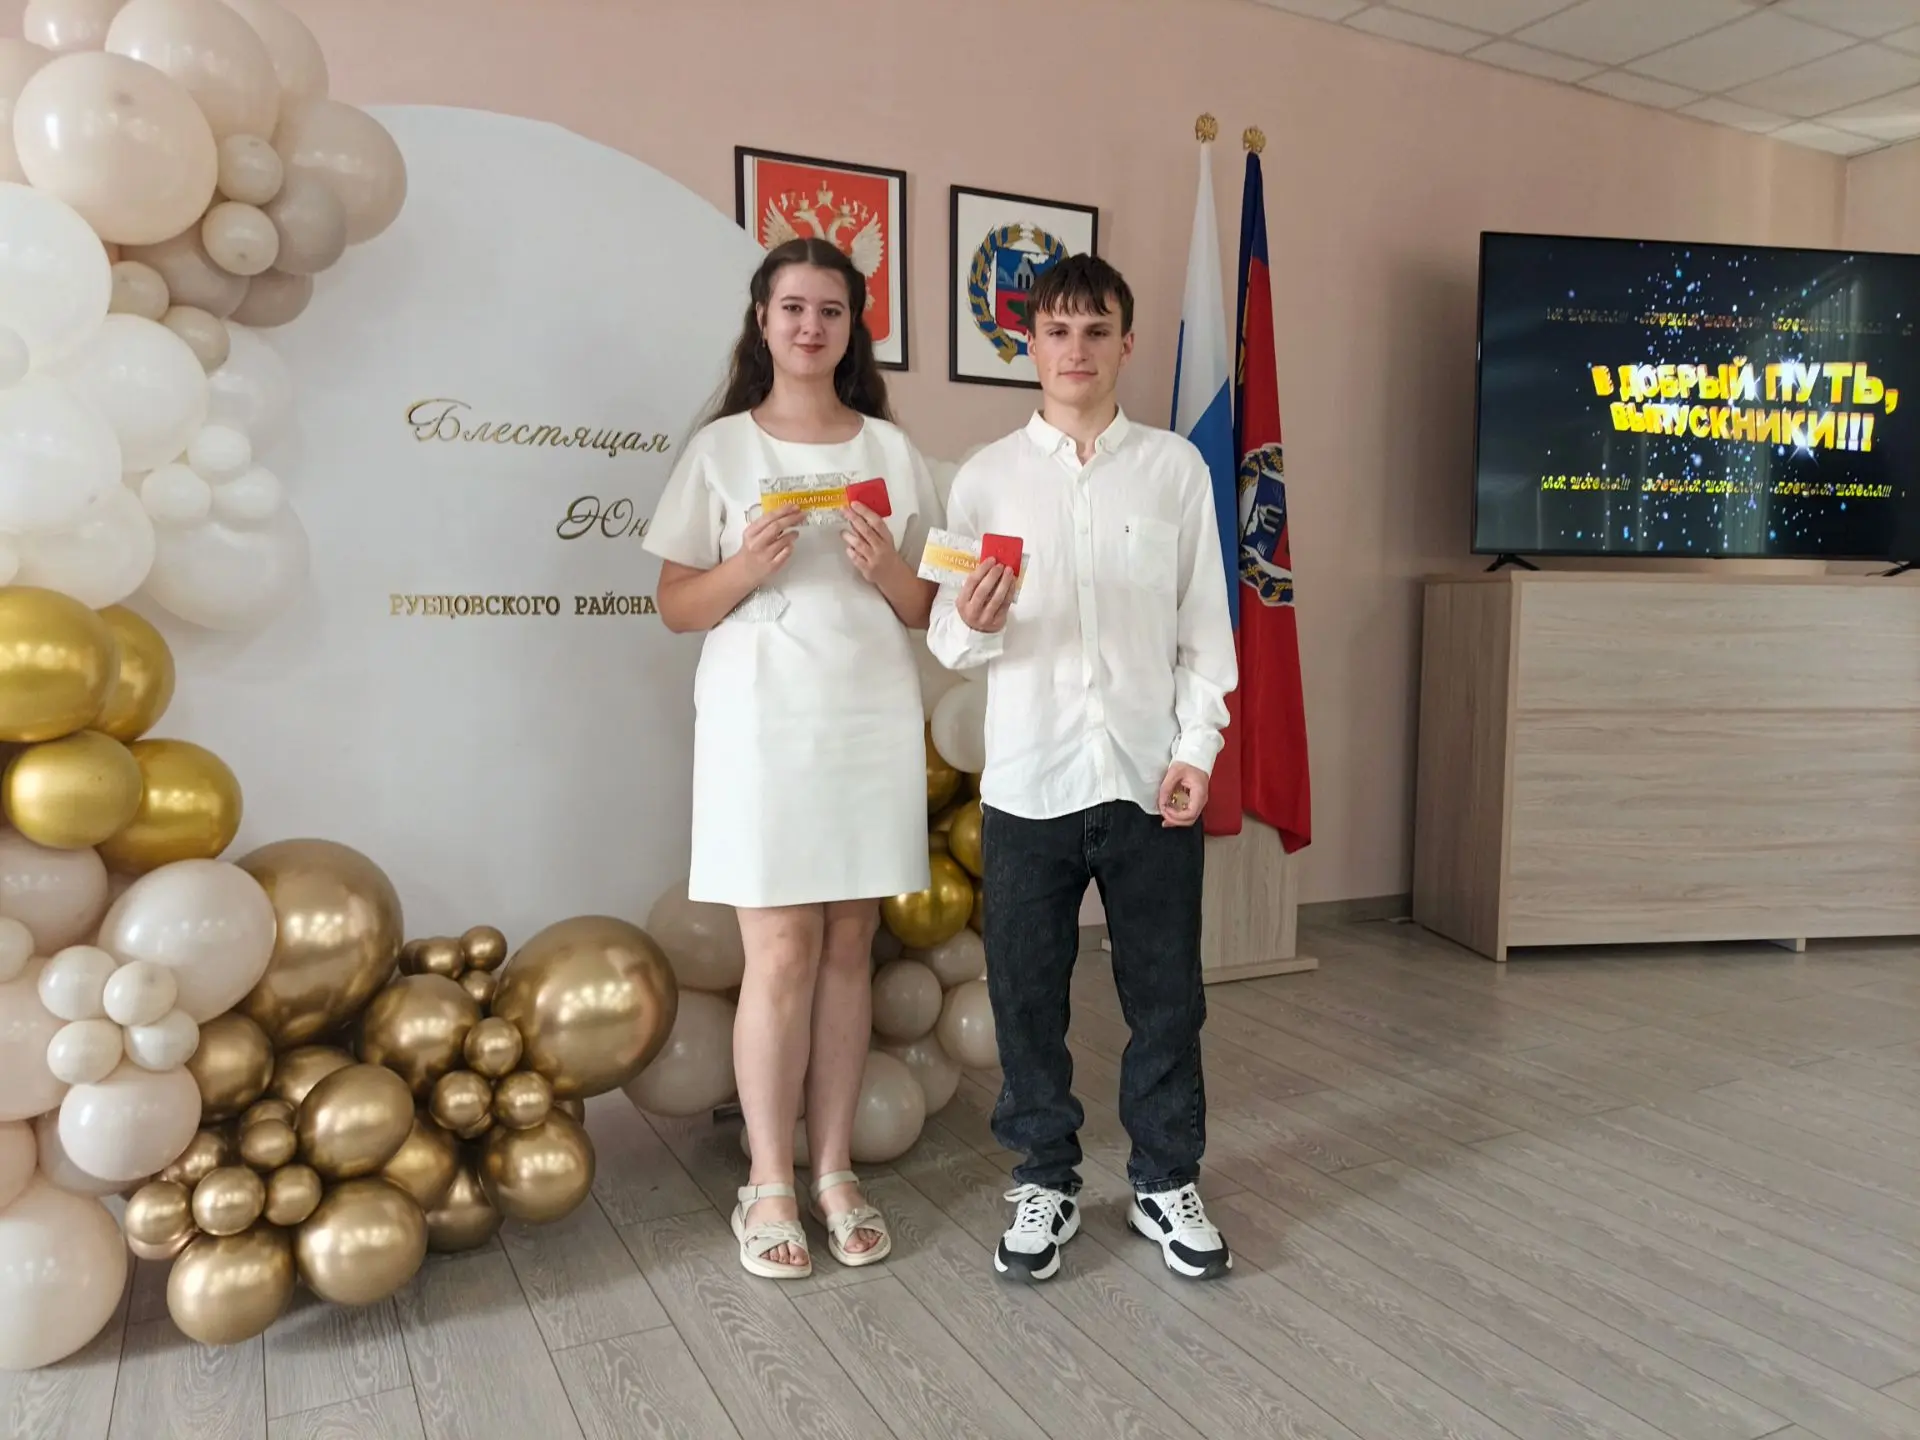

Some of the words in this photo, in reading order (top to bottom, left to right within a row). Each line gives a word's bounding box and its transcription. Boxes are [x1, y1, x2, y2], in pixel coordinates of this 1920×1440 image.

[1592, 365, 1614, 397] В
[1618, 356, 1757, 402] ДОБРЫЙ
[1765, 362, 1899, 415] ПУТЬ,
[405, 398, 671, 457] Блестящая
[1610, 402, 1875, 452] ВЫПУСКНИКИ!!!
[556, 495, 650, 540] Юн
[389, 593, 560, 620] РУБЦОВСКОГО
[574, 592, 657, 616] РАЙОНА
